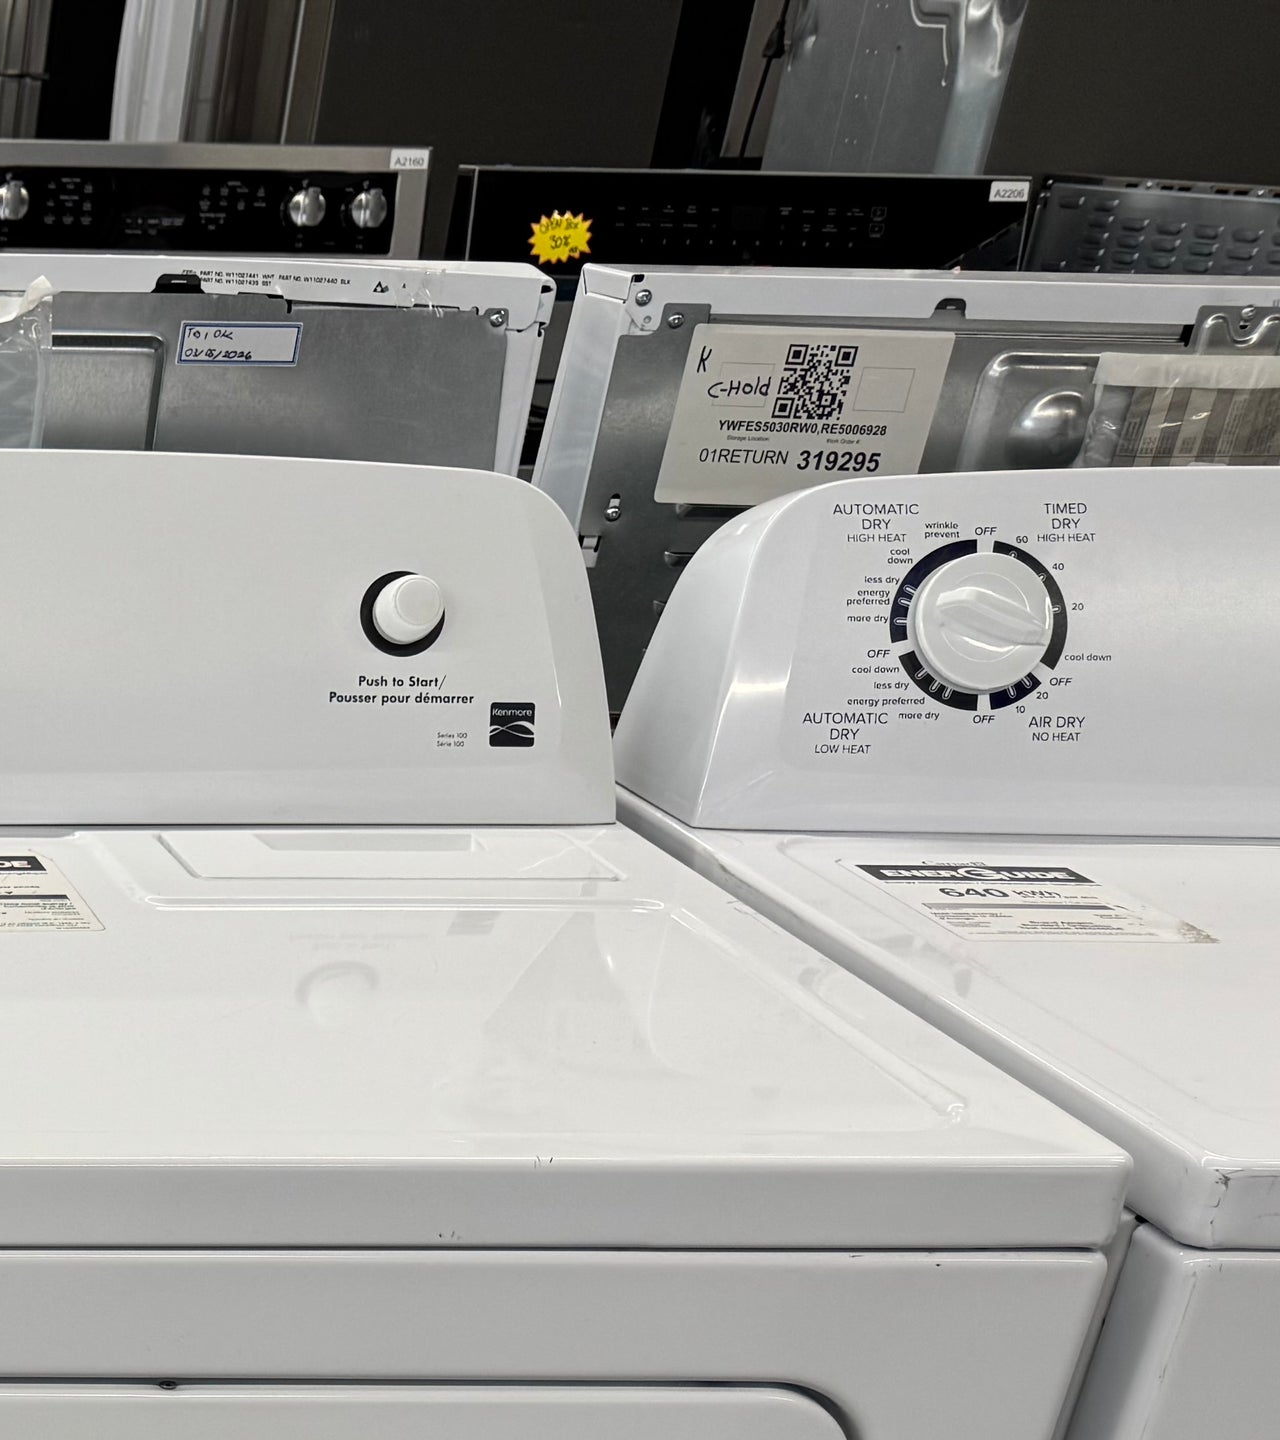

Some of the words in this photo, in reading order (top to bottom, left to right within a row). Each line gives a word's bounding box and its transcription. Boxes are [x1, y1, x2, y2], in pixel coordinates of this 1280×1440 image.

[395, 156, 425, 167] A2160
[993, 188, 1025, 199] A2206
[699, 448, 789, 465] 01RETURN
[796, 450, 881, 473] 319295
[833, 503, 920, 515] AUTOMATIC
[1043, 502, 1088, 515] TIMED
[861, 518, 891, 530] DRY
[924, 521, 959, 530] wrinkle
[1051, 518, 1081, 530] DRY
[847, 533, 875, 543] HIGH
[878, 533, 907, 543] HEAT
[924, 530, 960, 540] prevent
[1015, 535, 1029, 544] 60
[1037, 533, 1065, 543] HIGH
[890, 548, 910, 556] cool
[887, 556, 914, 565] down
[864, 575, 883, 584] less
[885, 575, 901, 586] dry
[857, 589, 891, 599] energy
[846, 597, 890, 607] preferred
[847, 614, 871, 623] more
[874, 614, 889, 625] dry
[867, 649, 891, 659] OFF
[851, 665, 872, 674] cool
[874, 665, 900, 674] down
[358, 675, 388, 687] Push
[392, 676, 404, 687] to
[408, 675, 447, 691] Start/
[873, 681, 892, 690] less
[329, 691, 377, 704] Pousser
[381, 693, 411, 706] pour
[414, 692, 475, 705] démarrer
[847, 697, 880, 707] energy
[881, 696, 926, 706] preferred
[491, 708, 533, 717] Kenmore
[898, 711, 922, 720] more
[802, 712, 889, 725] AUTOMATIC
[1028, 716, 1052, 728] AIR
[829, 728, 860, 741] DRY
[1031, 732, 1049, 742] NO
[814, 744, 839, 754] LOW
[842, 744, 871, 754] HEAT
[879, 866, 1077, 881] ENERGUIDE
[938, 887, 1010, 899] 640
